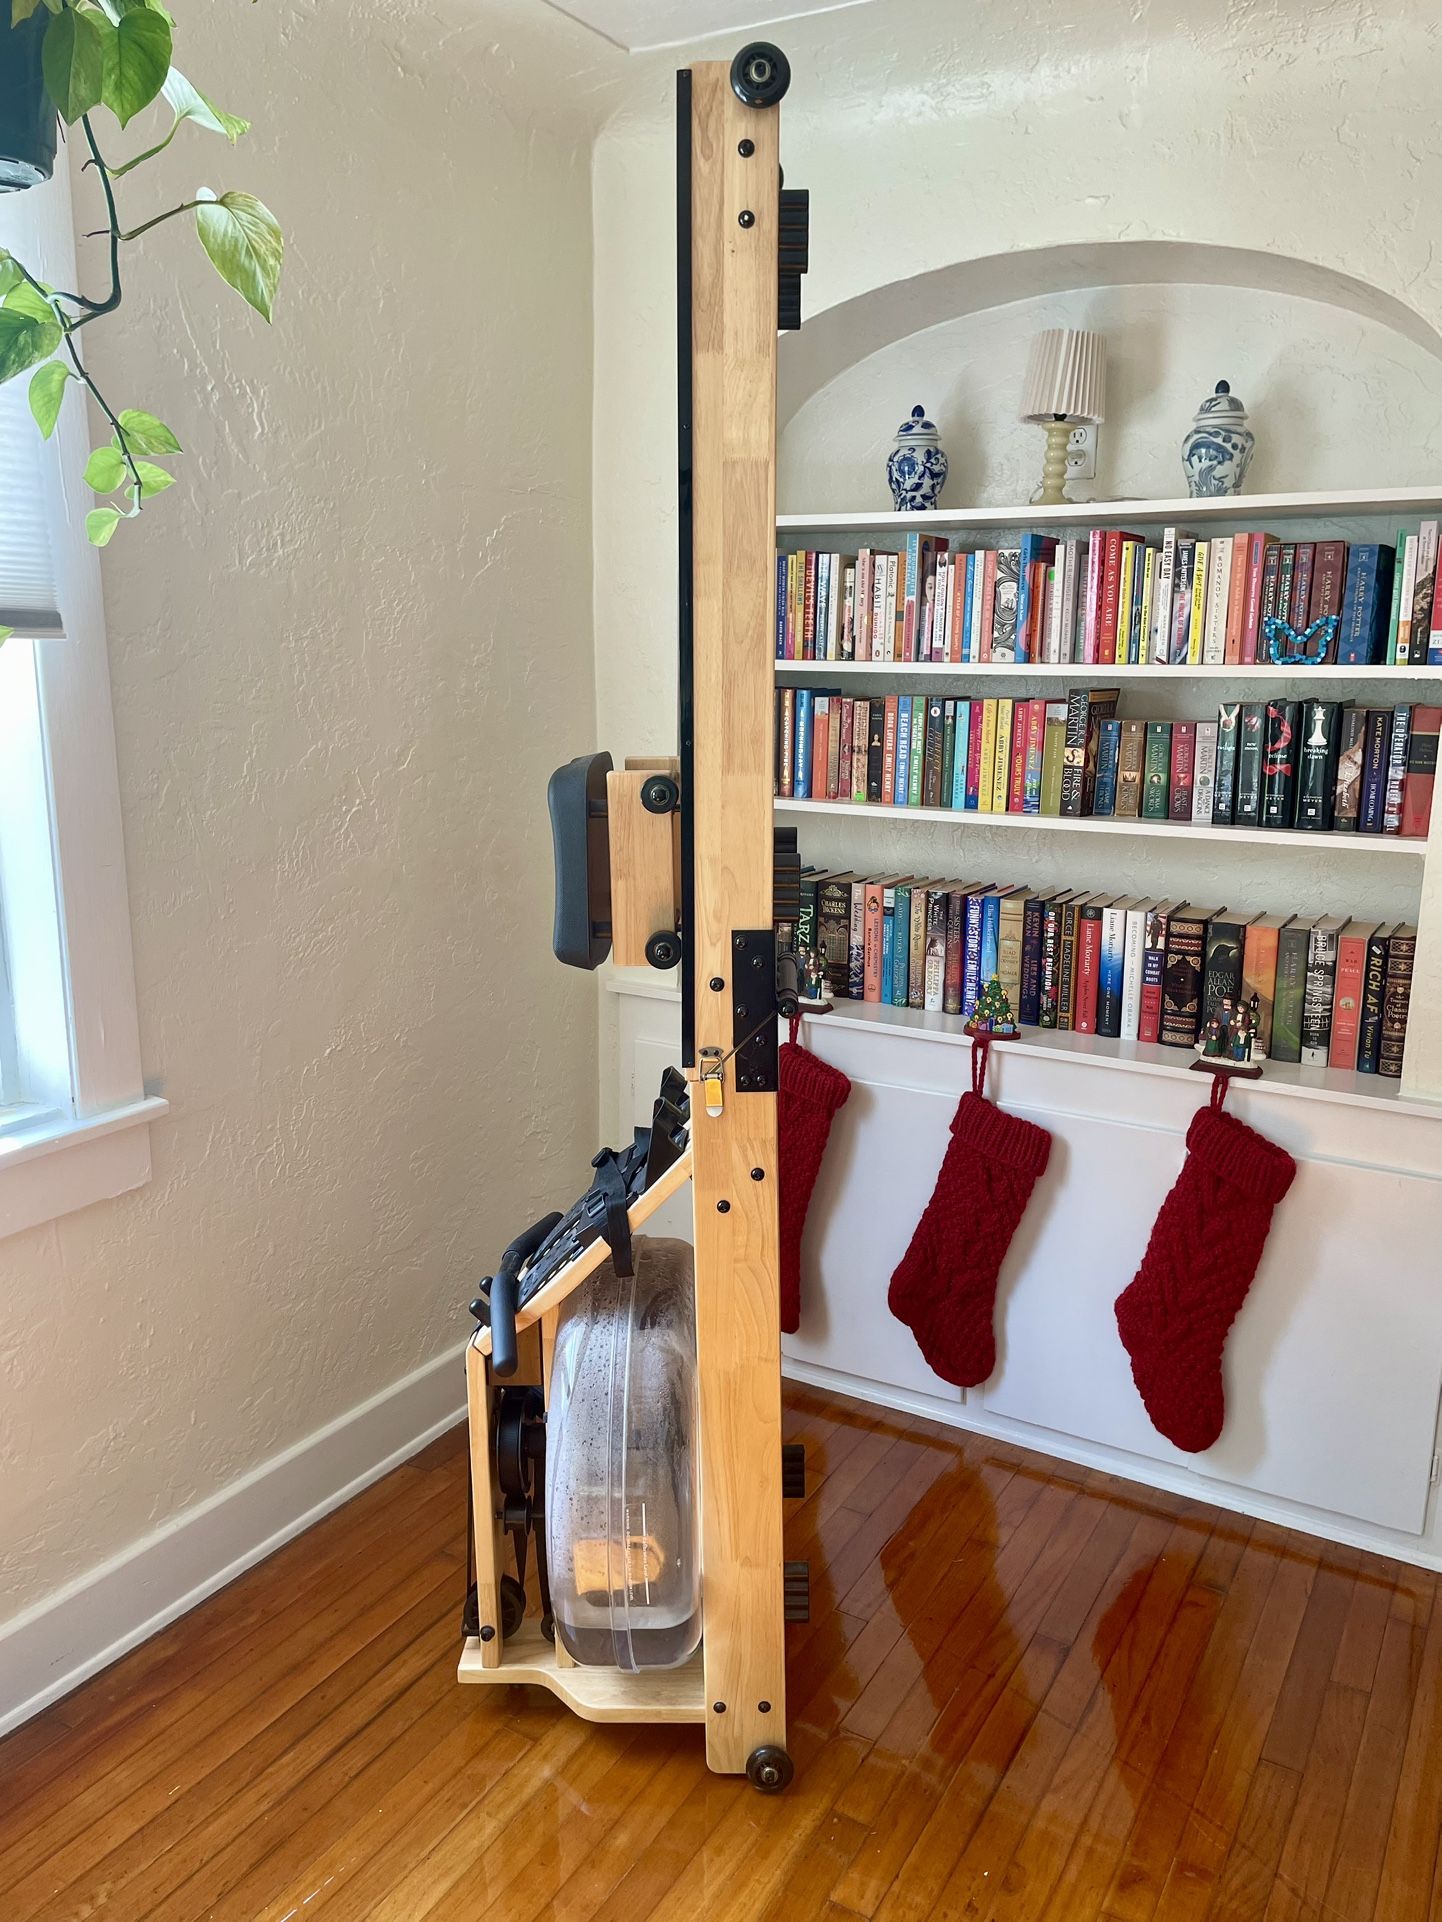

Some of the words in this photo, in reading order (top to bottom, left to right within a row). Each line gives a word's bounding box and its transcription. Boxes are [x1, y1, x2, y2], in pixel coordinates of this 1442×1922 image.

[1109, 538, 1117, 566] COME
[1165, 540, 1172, 549] NO
[1164, 551, 1172, 566] EASY
[888, 560, 896, 588] Platonic
[1108, 569, 1115, 581] AS
[1163, 568, 1171, 579] DAY
[1180, 565, 1188, 592] PATTERSON
[1324, 571, 1332, 601] HARRY
[1106, 584, 1114, 603] YOU
[1267, 575, 1275, 601] HARRY
[1283, 574, 1291, 600] HARRY
[1359, 572, 1367, 603] HARRY
[1354, 606, 1363, 637] POTTER
[1067, 694, 1080, 745] MARTIN
[1078, 694, 1087, 728] GEORGE
[1396, 713, 1407, 725] THE
[900, 713, 909, 738] BEACH
[1078, 729, 1084, 737] R.
[900, 740, 908, 759] READ
[927, 727, 935, 763] COUPLE
[933, 730, 942, 773] PERFECT
[1028, 736, 1036, 769] JIMENEZ
[1101, 742, 1109, 769] MARTIN
[1125, 742, 1133, 770] MARTIN
[1303, 747, 1328, 756] breaking
[1372, 737, 1381, 769] MORTON
[1393, 728, 1406, 764] OPERATOR
[1150, 744, 1159, 773] MARTIN
[1176, 744, 1184, 773] MARTIN
[1200, 745, 1209, 774] MARTIN
[885, 773, 893, 792] HENRY
[1061, 768, 1072, 801] BLOOD
[1073, 768, 1082, 788] FIRE
[1072, 789, 1080, 800] &
[1121, 785, 1129, 810] KINGS
[1174, 788, 1182, 813] CROWS
[1196, 789, 1204, 815] DRAGONS
[1367, 784, 1376, 821] HOMECOMING
[1389, 781, 1399, 805] ROBERT
[821, 900, 846, 908] CHARLES
[822, 906, 846, 914] DICKENS
[853, 902, 862, 932] Wedding
[968, 905, 980, 928] FUNNY
[1048, 911, 1055, 922] ON
[1032, 912, 1040, 937] KEVIN
[1047, 923, 1055, 937] OUR
[1065, 911, 1073, 935] CIRCE
[1086, 923, 1094, 943] Liane
[1109, 912, 1117, 932] Liane
[968, 929, 980, 953] STORY
[1107, 933, 1116, 963] Moriarty
[1130, 921, 1138, 957] BECOMING
[1314, 935, 1326, 965] BRUCE
[966, 960, 978, 980] EMILY
[1030, 960, 1038, 975] LIES
[1062, 941, 1072, 982] MADELINE
[1083, 944, 1093, 976] Moriarty
[926, 959, 934, 995] GREGORY
[1022, 955, 1030, 999] WEDDINGS
[1045, 958, 1053, 990] BEHAVIOR
[1127, 968, 1135, 1000] MICHELLE
[1208, 971, 1234, 979] EDGAR
[1208, 978, 1234, 986] ALLAN
[1368, 957, 1382, 990] RICH
[965, 982, 977, 1004] HENRY
[1061, 984, 1070, 1011] MILLER
[1208, 985, 1234, 997] POE
[1311, 969, 1323, 1030] SPRINGSTEEN
[1366, 994, 1379, 1013] AF
[1365, 1025, 1374, 1048] Vivian
[1365, 1050, 1371, 1059] Tu
